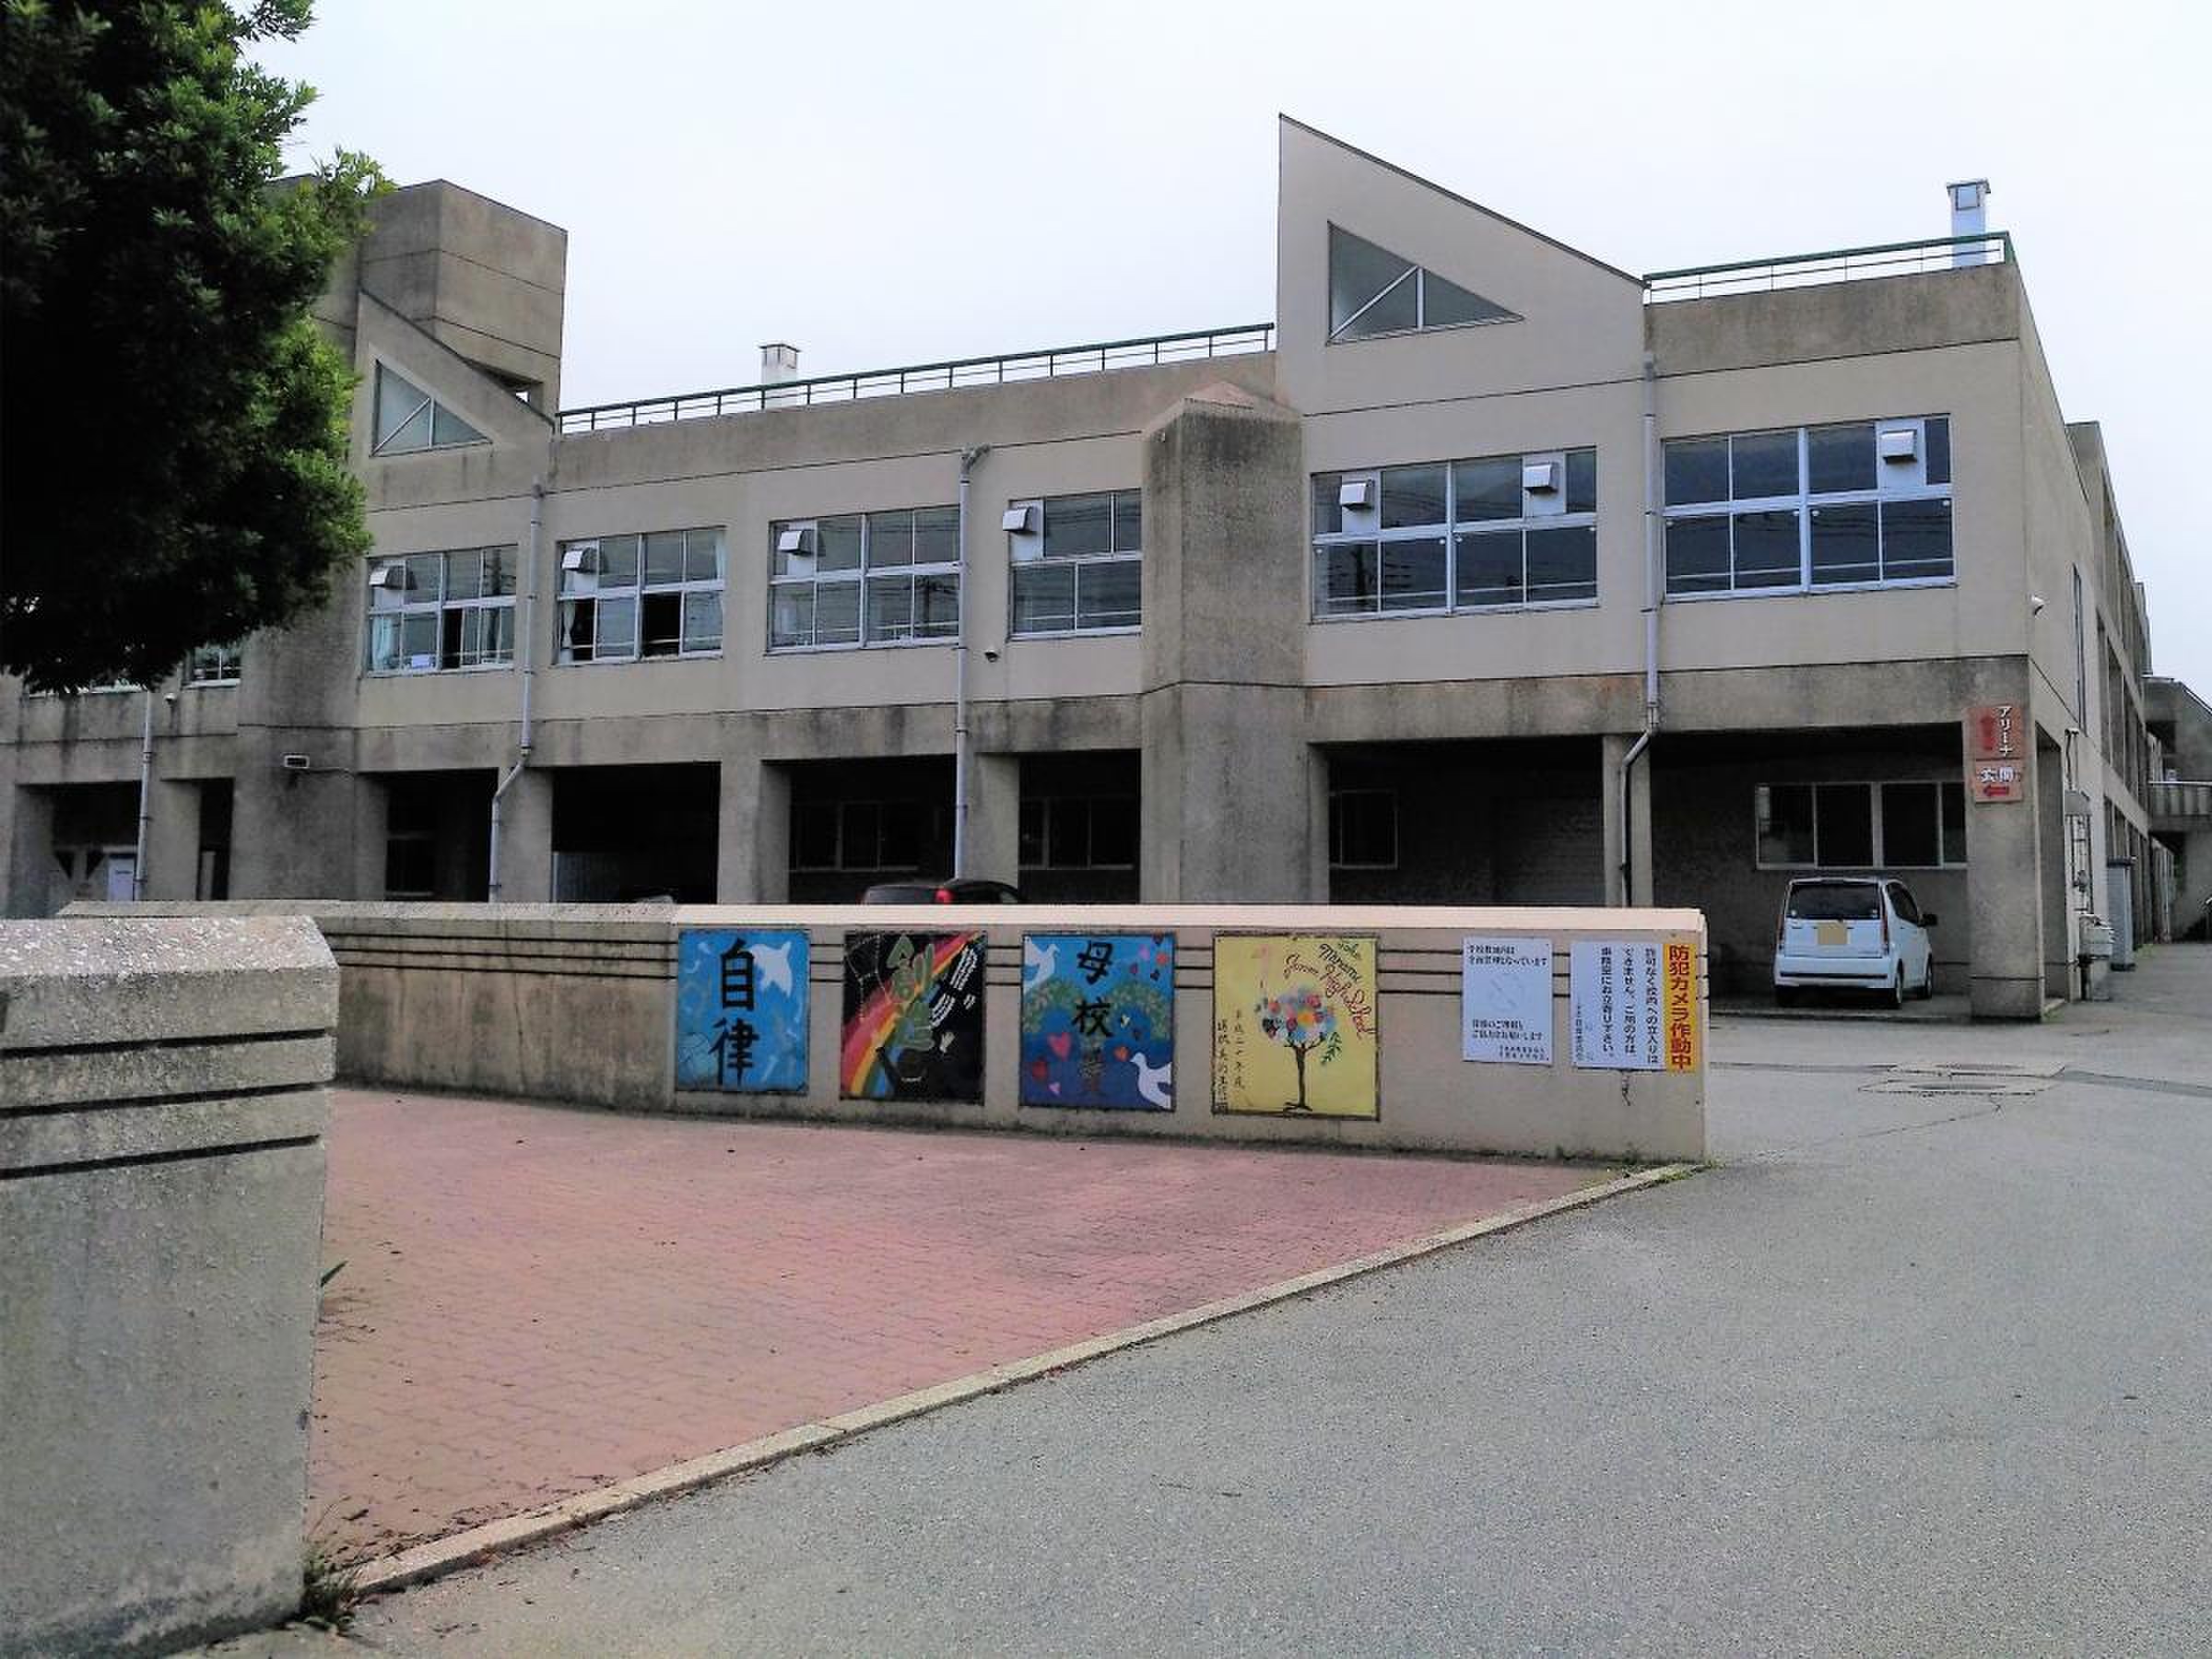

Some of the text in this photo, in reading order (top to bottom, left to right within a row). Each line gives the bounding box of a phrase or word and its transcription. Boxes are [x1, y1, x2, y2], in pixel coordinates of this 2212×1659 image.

[1979, 766, 2016, 783] 玄関
[1996, 705, 2014, 758] アリーナ
[708, 937, 760, 1087] 自律
[1668, 944, 1692, 1070] 防犯カメラ作動中
